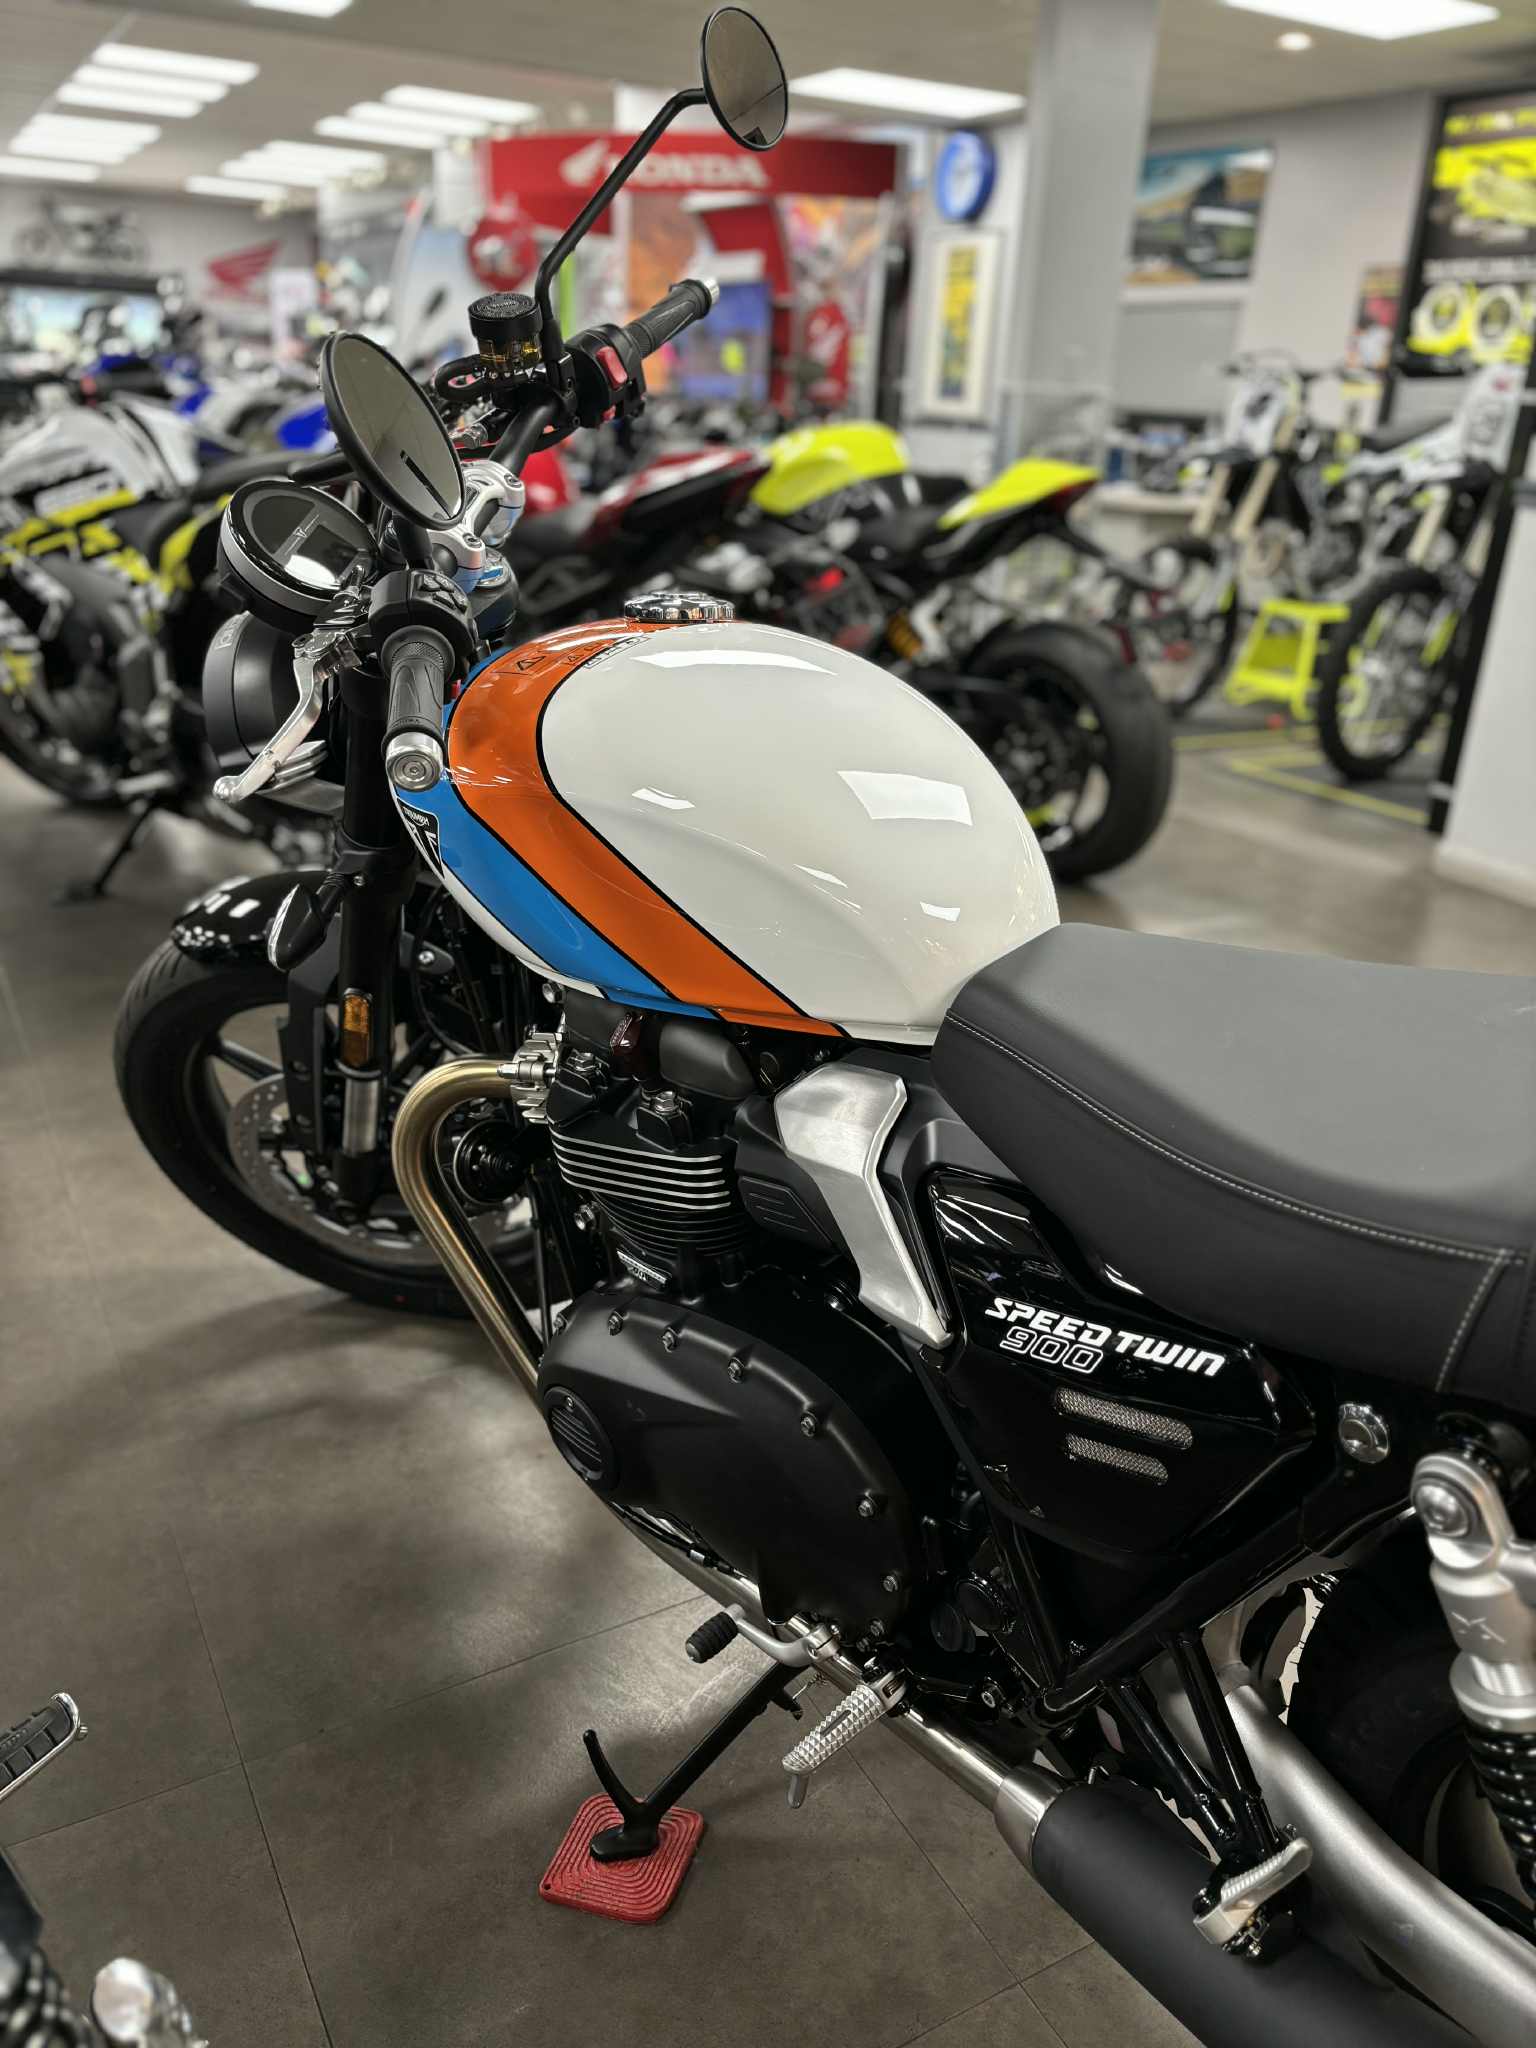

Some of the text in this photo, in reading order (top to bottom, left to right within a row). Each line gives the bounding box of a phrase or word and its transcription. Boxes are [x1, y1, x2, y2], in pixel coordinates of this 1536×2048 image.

[985, 1297, 1226, 1376] SPEED TWIN
[999, 1325, 1104, 1374] 900
